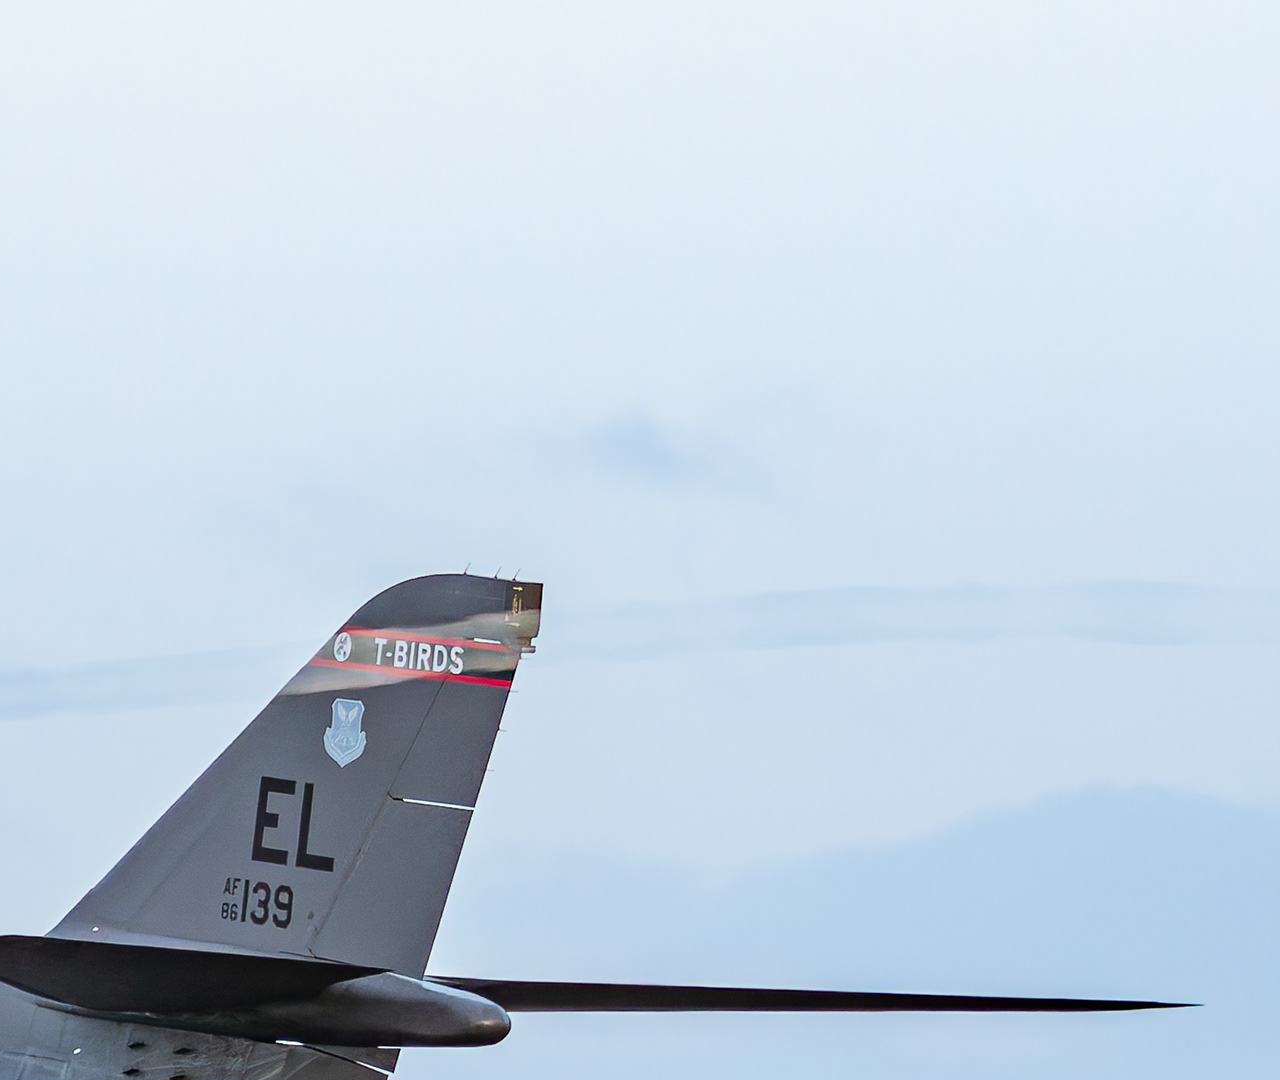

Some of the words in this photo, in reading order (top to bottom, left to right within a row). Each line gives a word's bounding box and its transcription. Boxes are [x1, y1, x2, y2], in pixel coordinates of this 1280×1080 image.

[374, 637, 465, 675] T-BIRDS
[251, 776, 335, 872] EL
[223, 877, 241, 896] AF
[241, 879, 293, 929] 139
[221, 902, 238, 921] 86
